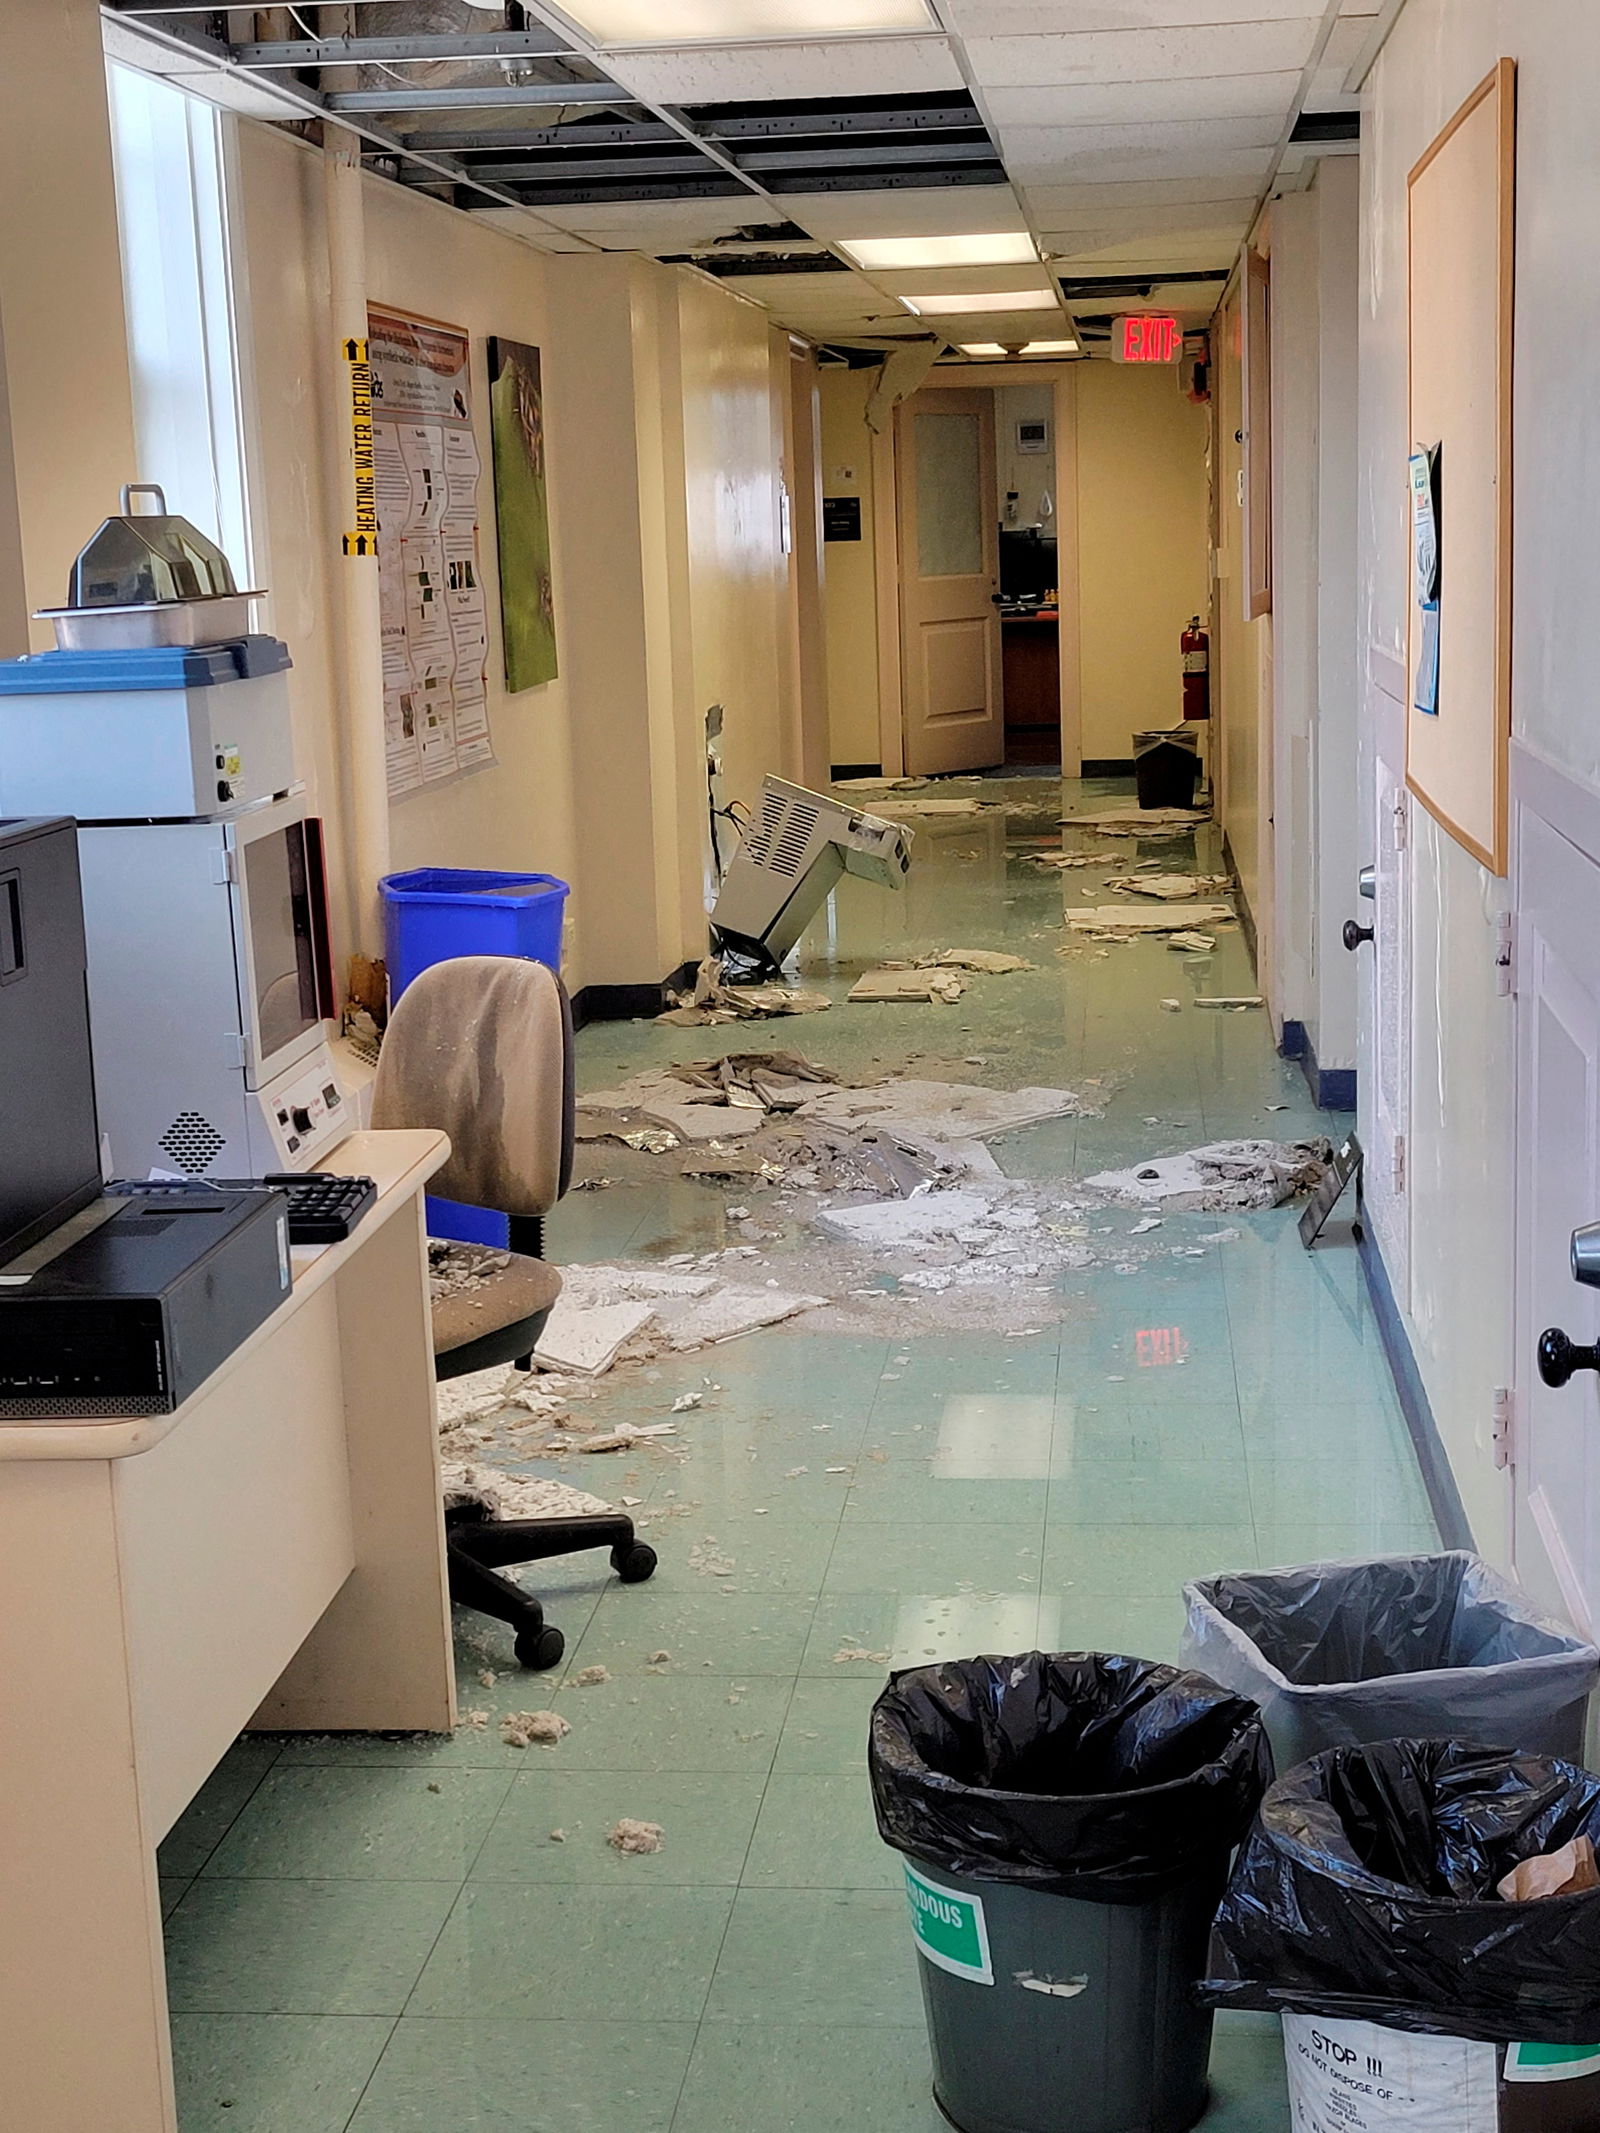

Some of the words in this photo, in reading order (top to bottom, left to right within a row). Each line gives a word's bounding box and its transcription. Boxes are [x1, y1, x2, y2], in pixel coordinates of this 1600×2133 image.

[1124, 318, 1176, 362] EXIT
[351, 362, 371, 416] RETURN
[354, 424, 374, 469] WATER
[356, 476, 376, 532] HEATING
[1298, 2042, 1310, 2059] DO
[1311, 2053, 1328, 2073] NOT
[1330, 2067, 1374, 2096] DISPOSE
[1376, 2088, 1394, 2101] OF
[1311, 2029, 1358, 2067] STOP
[1366, 2056, 1384, 2078] !!!
